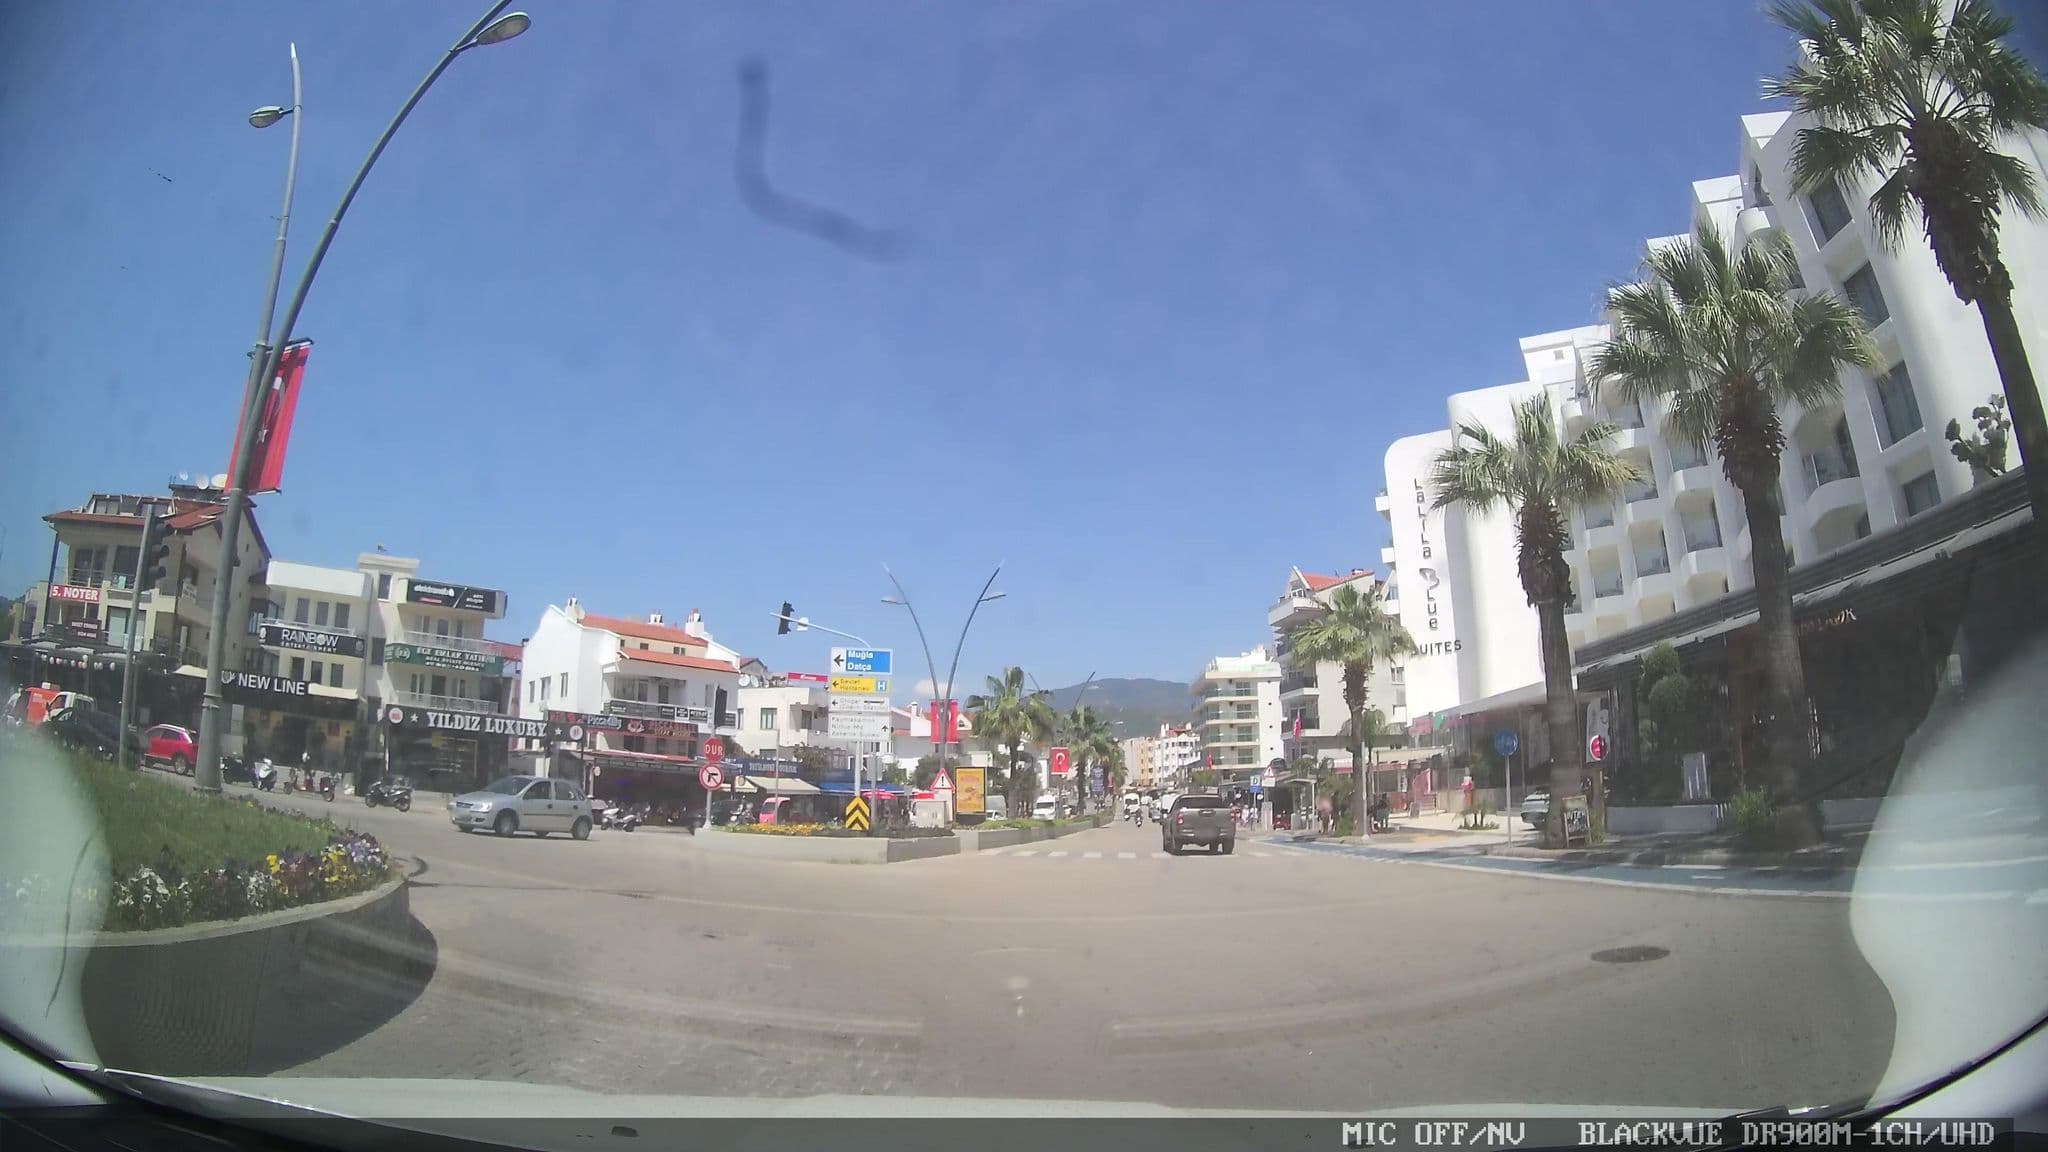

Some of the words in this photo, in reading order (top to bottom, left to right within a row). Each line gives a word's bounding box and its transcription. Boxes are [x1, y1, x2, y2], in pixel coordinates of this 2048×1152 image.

[52, 586, 61, 597] 5.
[63, 587, 98, 601] NOTER
[281, 629, 339, 647] RAINBOW
[847, 662, 872, 672] Datça
[238, 672, 270, 690] NEW
[273, 679, 305, 696] LINE
[877, 681, 886, 691] H
[426, 712, 480, 731] YILDIZ
[485, 717, 547, 737] LUXURY
[705, 744, 723, 756] DUR
